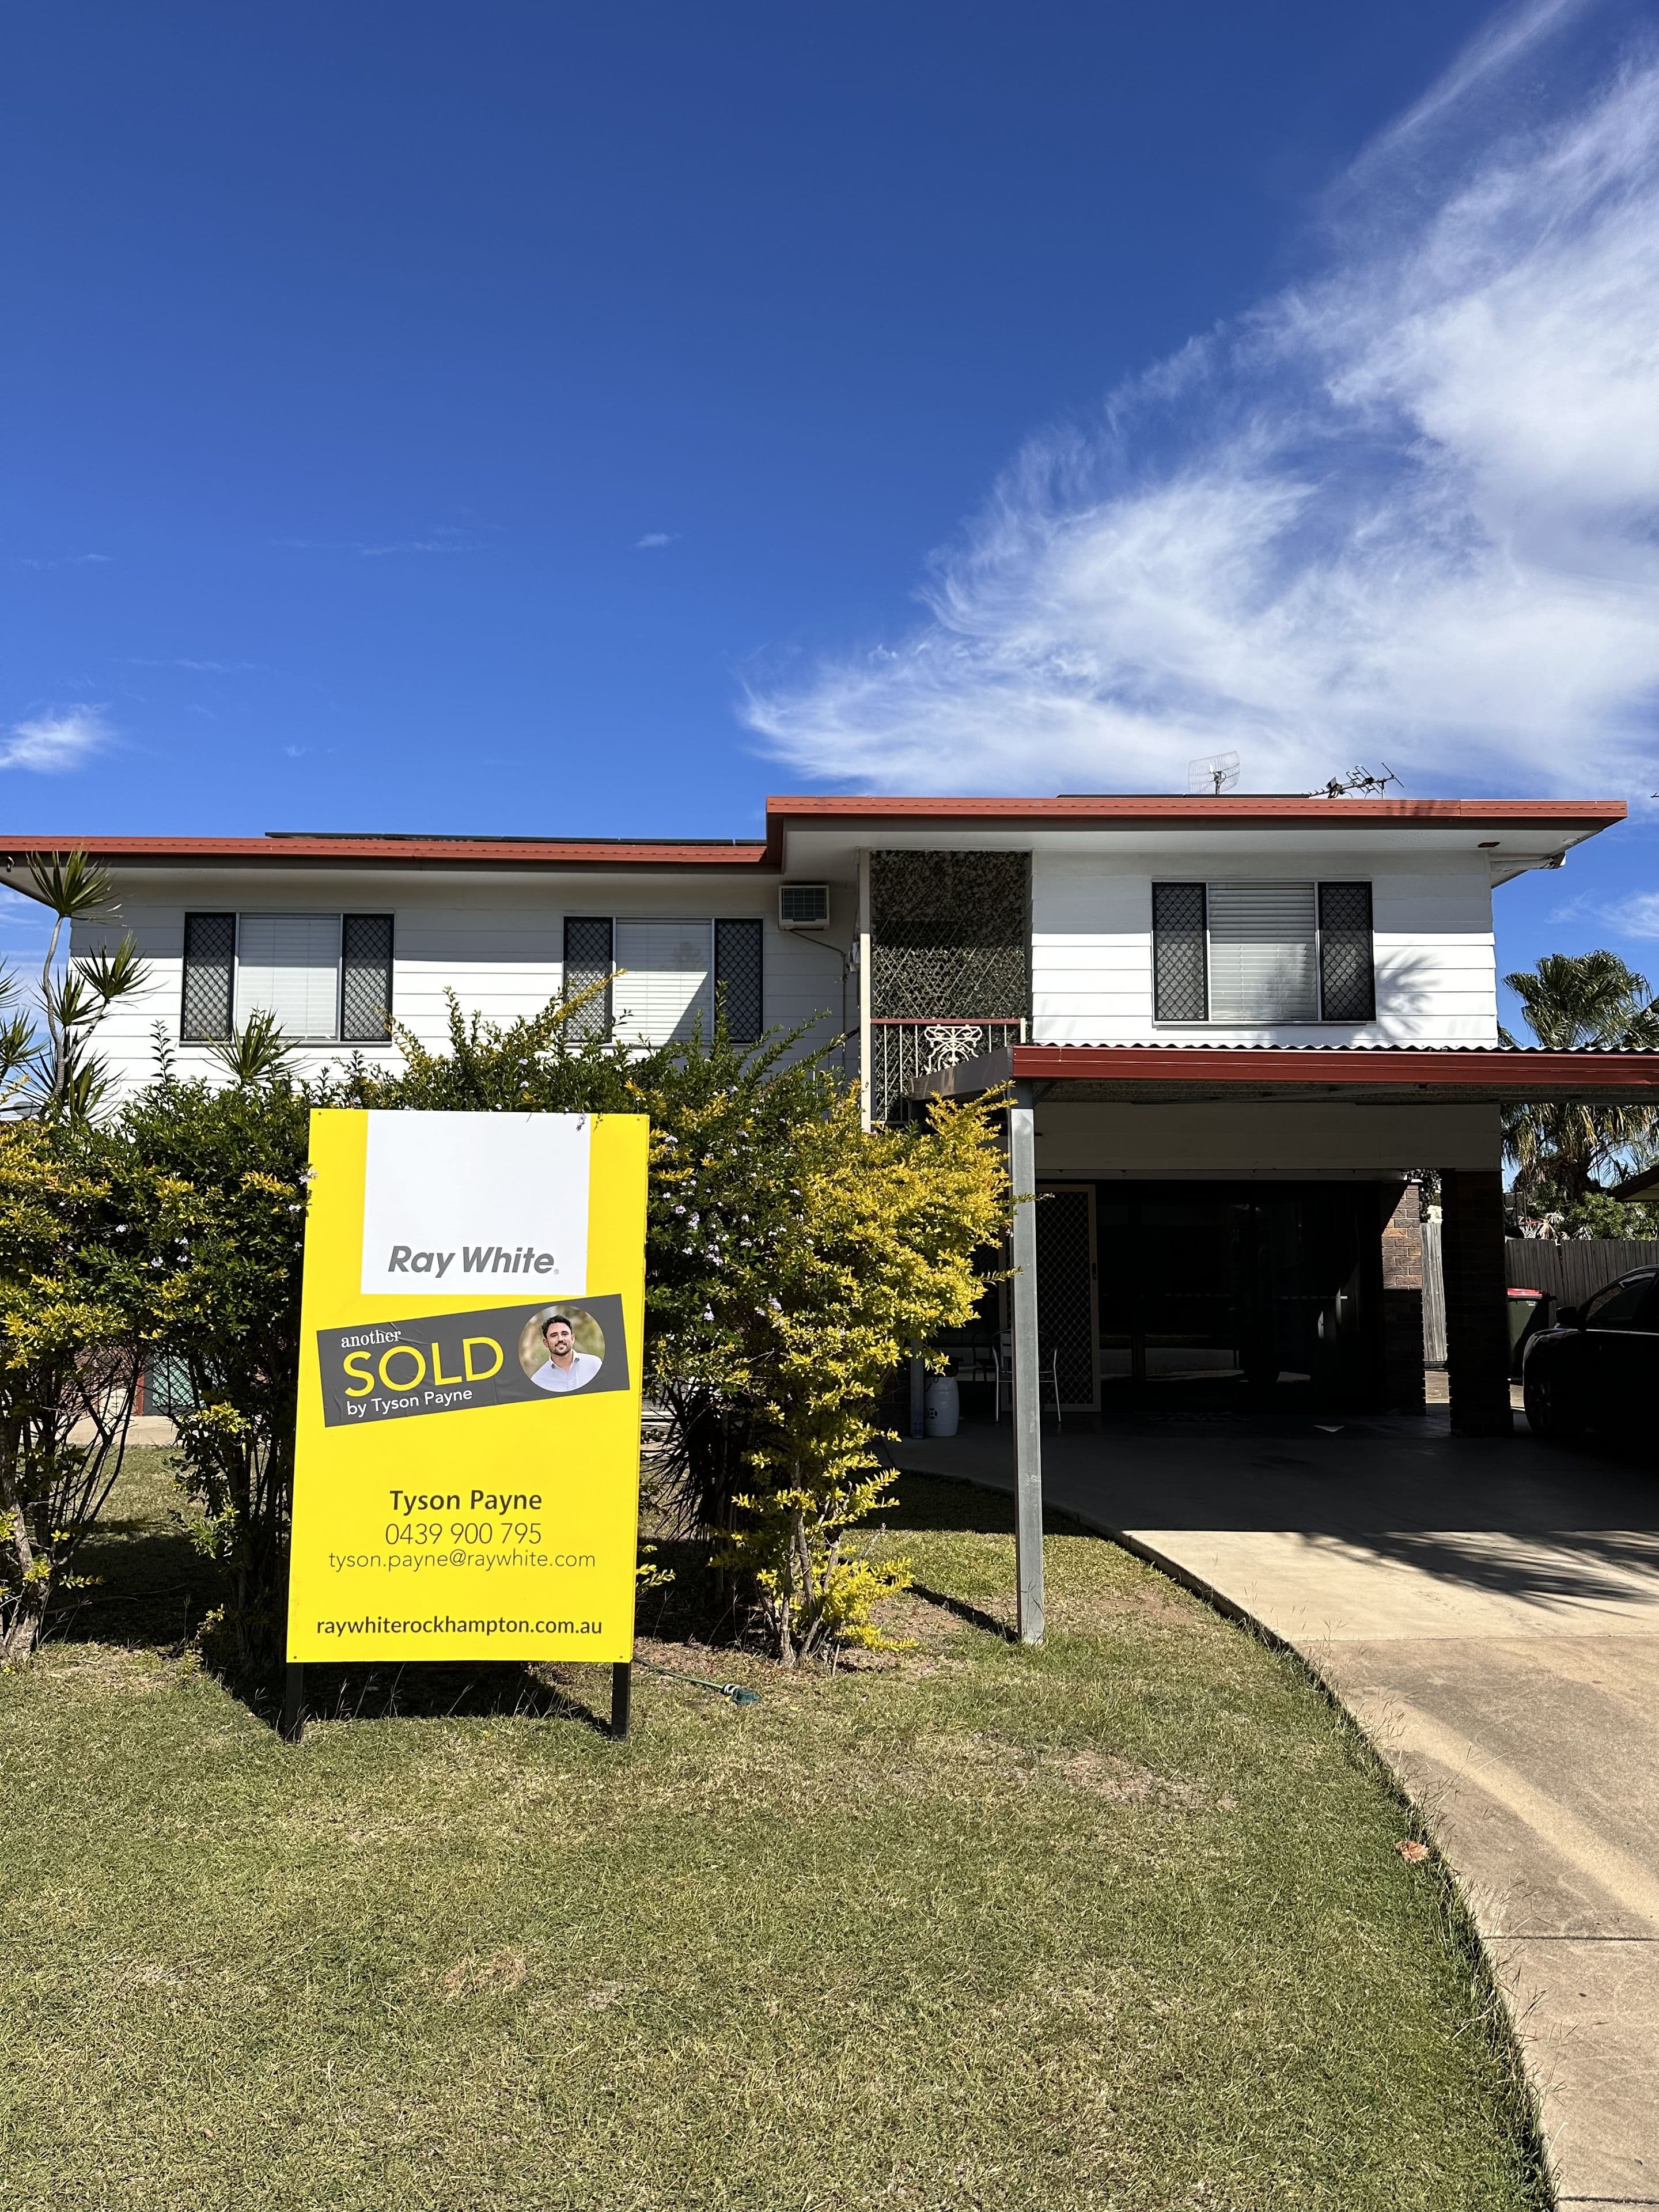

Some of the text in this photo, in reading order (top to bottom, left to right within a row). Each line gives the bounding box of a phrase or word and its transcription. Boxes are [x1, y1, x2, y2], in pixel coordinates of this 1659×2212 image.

[388, 1245, 555, 1278] Ray White
[340, 1328, 402, 1349] another
[343, 1336, 505, 1397] SOLD
[347, 1388, 473, 1419] by Tyson Payne
[390, 1490, 543, 1516] Tyson Payne
[385, 1522, 542, 1545] 0439 900 795
[328, 1548, 596, 1573] tyson.payne@raywhite.com
[316, 1616, 603, 1637] raywhiterockhampton.com.au
